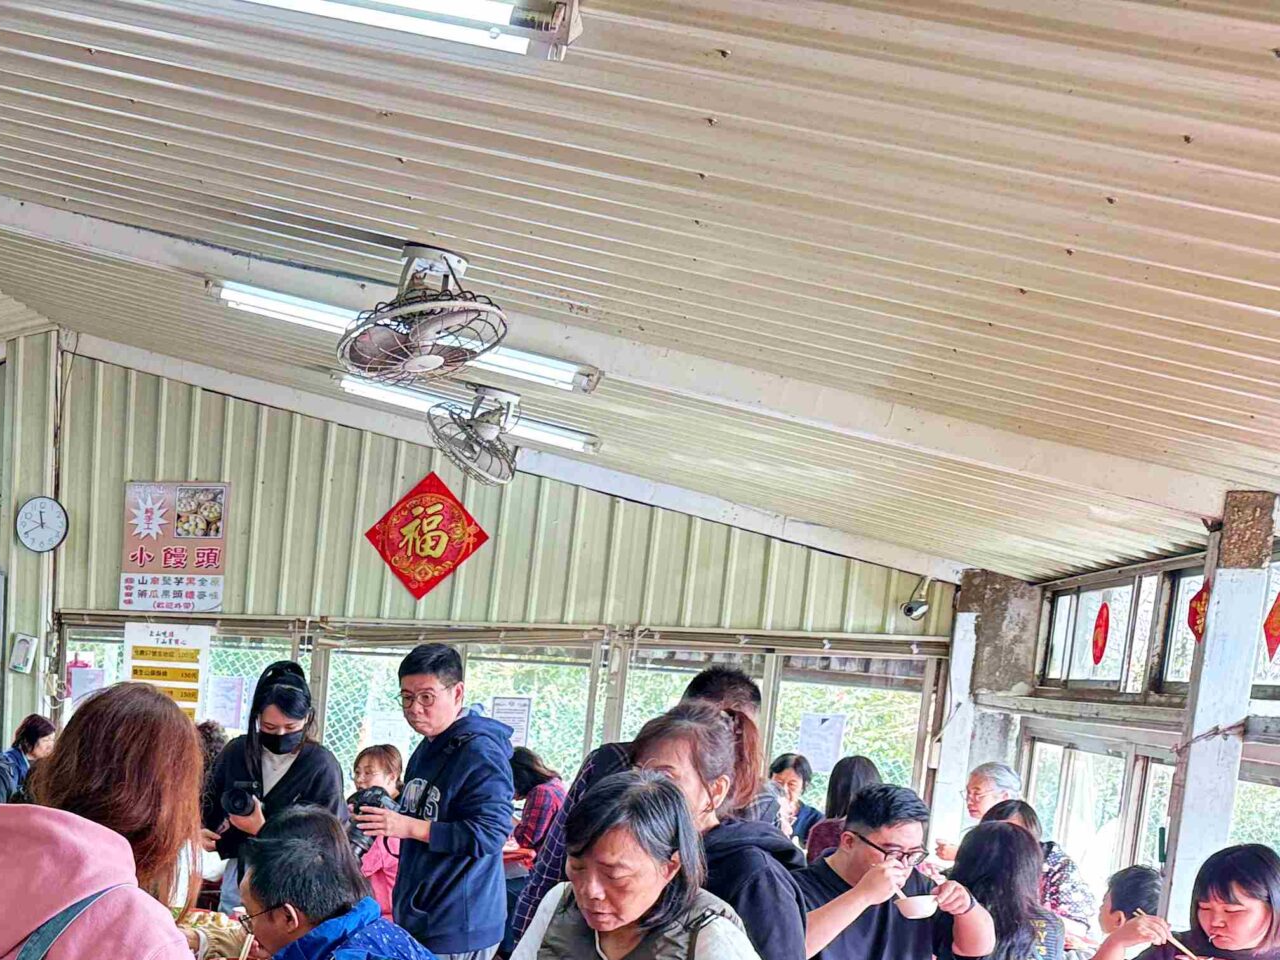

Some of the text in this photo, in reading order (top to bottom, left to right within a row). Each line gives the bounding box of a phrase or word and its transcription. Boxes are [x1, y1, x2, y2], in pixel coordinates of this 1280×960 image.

[399, 502, 450, 558] 福
[129, 545, 221, 569] 小饅頭
